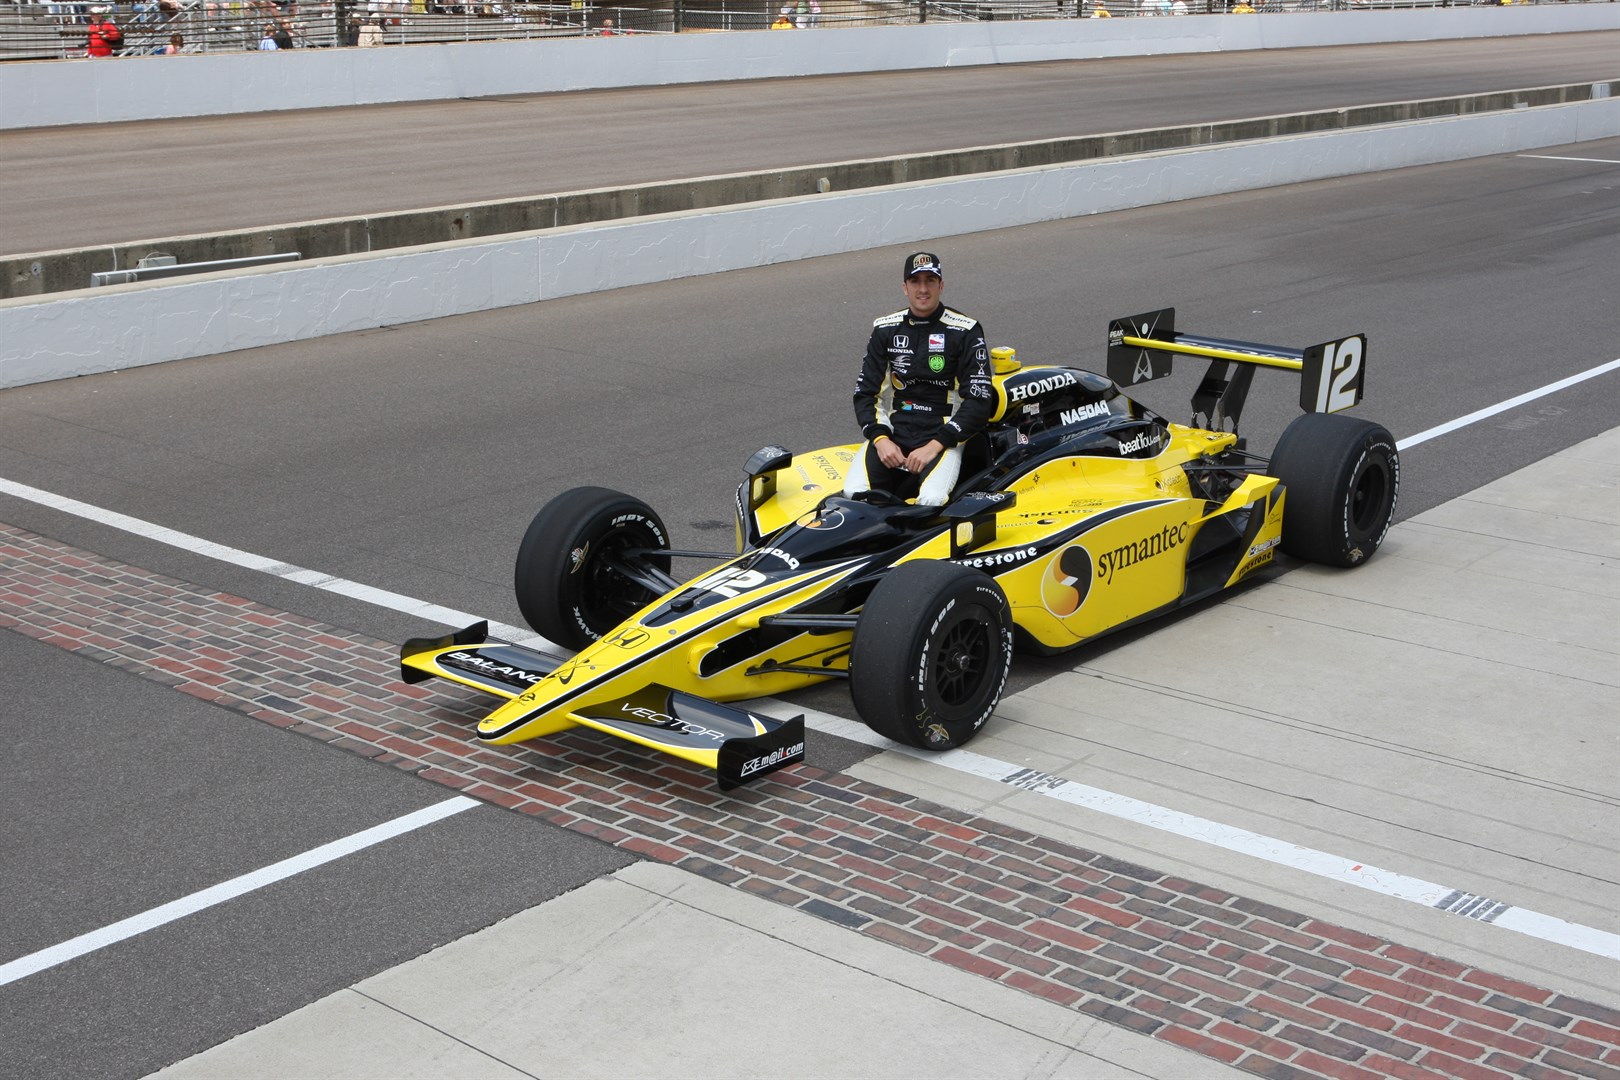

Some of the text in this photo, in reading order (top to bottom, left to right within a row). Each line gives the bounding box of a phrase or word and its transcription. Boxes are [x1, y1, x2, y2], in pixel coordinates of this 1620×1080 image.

[887, 347, 915, 355] HONDA
[1010, 372, 1077, 402] HONDA
[1315, 336, 1363, 413] 12
[912, 403, 932, 412] Tomas
[1060, 400, 1111, 426] NASDAQ
[611, 514, 666, 546] INDY 500
[949, 546, 1038, 569] restone
[1097, 520, 1188, 586] symantec
[690, 566, 767, 599] 12
[976, 586, 1003, 604] Firestone
[930, 598, 955, 635] 500
[918, 638, 929, 691] INDY
[621, 702, 726, 741] VECTOR
